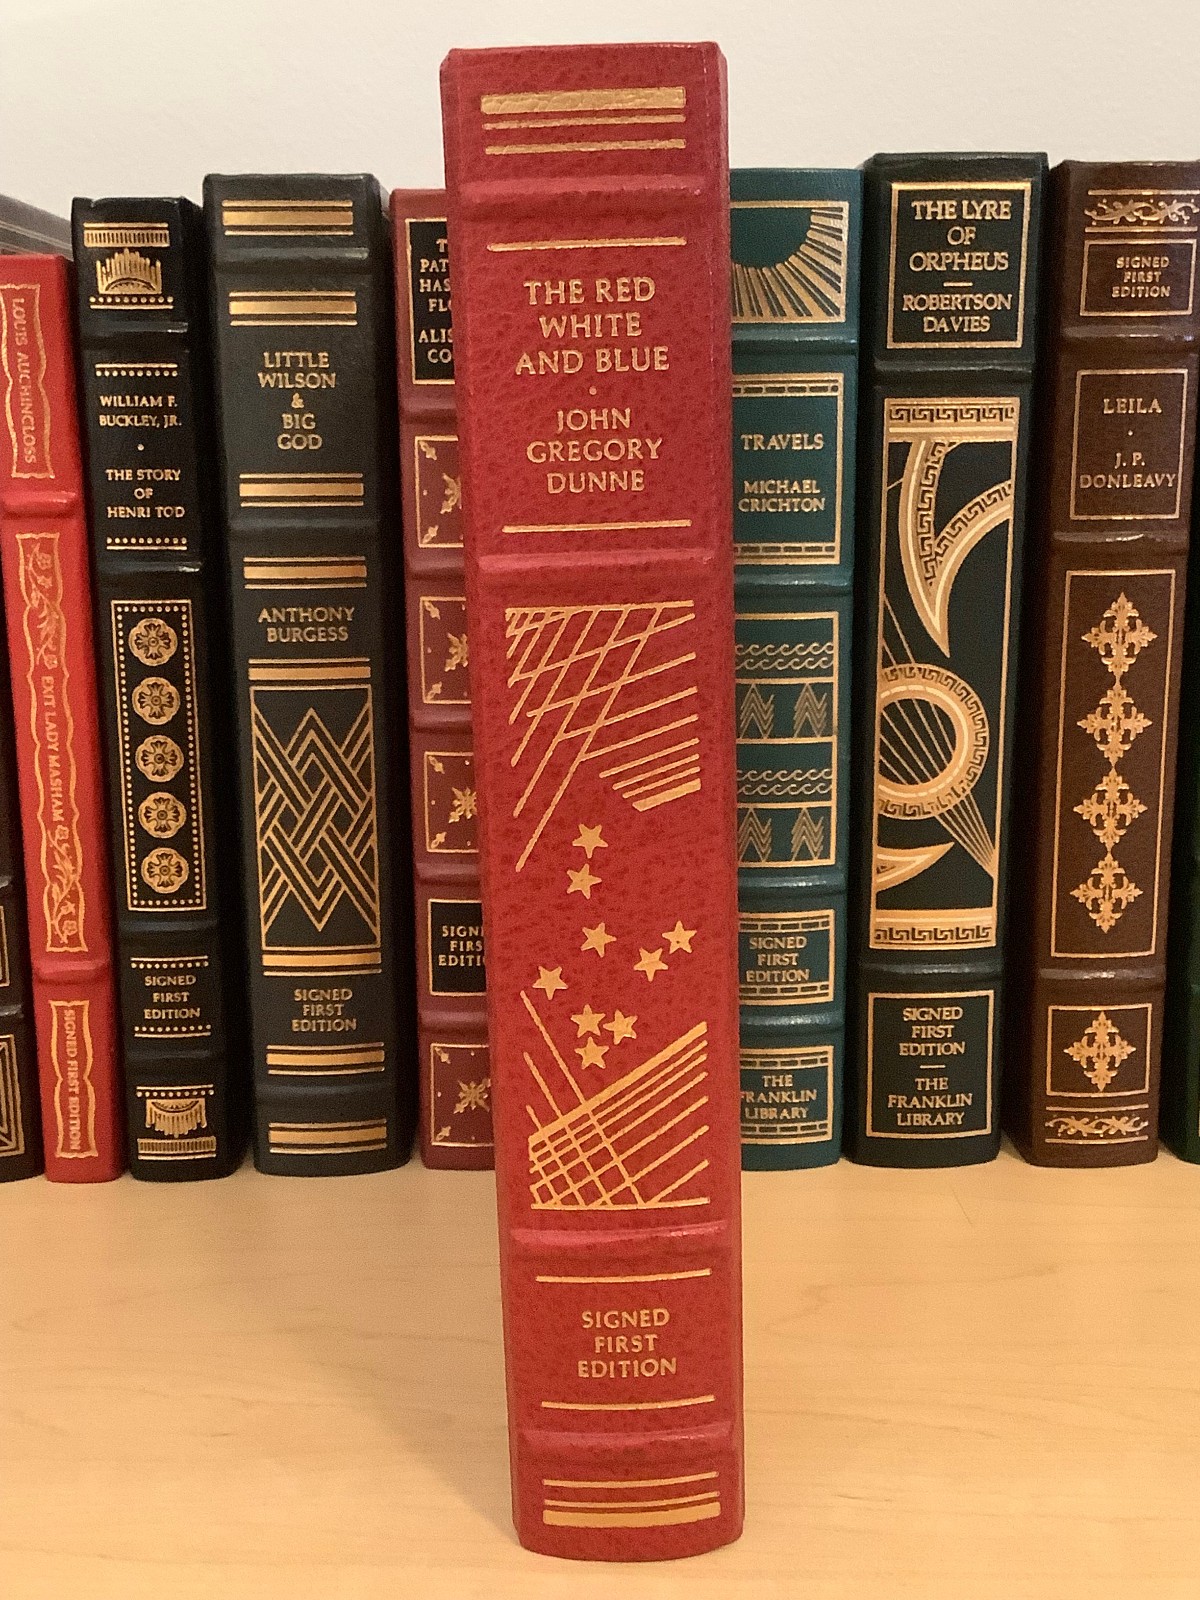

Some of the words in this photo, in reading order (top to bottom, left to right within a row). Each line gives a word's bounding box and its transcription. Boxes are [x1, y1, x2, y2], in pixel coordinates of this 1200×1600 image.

[911, 201, 957, 221] THE
[961, 200, 1012, 220] LYRE
[948, 226, 976, 245] OF
[909, 251, 1009, 272] ORPHEUS
[1116, 256, 1170, 269] SIGNED
[419, 278, 451, 292] HAS
[1123, 271, 1162, 283] FIRST
[523, 278, 585, 306] THE
[595, 277, 656, 303] RED
[1111, 286, 1171, 298] EDITION
[902, 294, 1013, 311] ROBERTSON
[12, 297, 28, 346] LOUIS
[539, 312, 643, 338] WHITE
[923, 316, 991, 333] DAVIES
[418, 328, 453, 343] ALIS
[263, 352, 330, 369] LITTLE
[515, 350, 584, 375] AND
[595, 346, 670, 373] BLUE
[257, 372, 337, 389] WILSON
[17, 352, 37, 464] AUCHINCLOSS
[99, 395, 163, 407] WILLIAM
[167, 396, 178, 407] F.
[292, 393, 304, 409] &
[1103, 398, 1162, 414] LEILA
[99, 415, 160, 428] BUCKLEY,
[163, 414, 182, 428] JR.
[282, 413, 316, 430] BIG
[556, 408, 631, 431] JOHN
[277, 433, 323, 450] GOD
[740, 433, 825, 451] TRAVELS
[526, 437, 663, 464] GREGORY
[1114, 453, 1127, 469] J.
[1132, 452, 1146, 466] P.
[105, 469, 133, 481] THE
[136, 469, 181, 481] STORY
[547, 470, 646, 494] DUNNE
[1079, 473, 1176, 489] DONLEAVY
[134, 487, 153, 499] OF
[744, 479, 821, 494] MICHAEL
[107, 506, 150, 518] HENRI
[155, 506, 185, 518] TOD
[738, 498, 826, 512] CRICHTON
[258, 607, 355, 624] ANTHONY
[267, 625, 349, 642] BURGESS
[41, 676, 55, 709] EXIT
[44, 711, 60, 752] LADY
[47, 755, 65, 821] MASHAM
[442, 925, 484, 937] SIGN
[450, 940, 483, 952] FIRS
[749, 936, 808, 950] SIGNED
[438, 954, 485, 967] EDITI
[757, 953, 799, 966] FIRST
[144, 973, 197, 987] SIGNED
[746, 969, 810, 983] EDITION
[153, 991, 190, 1003] FIRST
[294, 988, 353, 1002] SIGNED
[143, 1007, 201, 1020] EDITION
[303, 1003, 345, 1017] FIRST
[902, 1007, 963, 1022] SIGNED
[63, 1009, 78, 1058] SIGNED
[291, 1018, 357, 1033] EDITION
[912, 1025, 955, 1039] FIRST
[899, 1041, 966, 1057] EDITION
[66, 1060, 79, 1094] FIRST
[762, 1074, 793, 1087] THE
[915, 1077, 949, 1091] THE
[888, 1093, 973, 1108] FRANKLIN
[745, 1107, 809, 1120] LIBRARY
[896, 1112, 965, 1127] LIBRARY
[68, 1096, 81, 1151] EDITION
[581, 1308, 670, 1329] SIGNED
[594, 1334, 658, 1353] FIRST
[577, 1357, 677, 1378] EDITION
